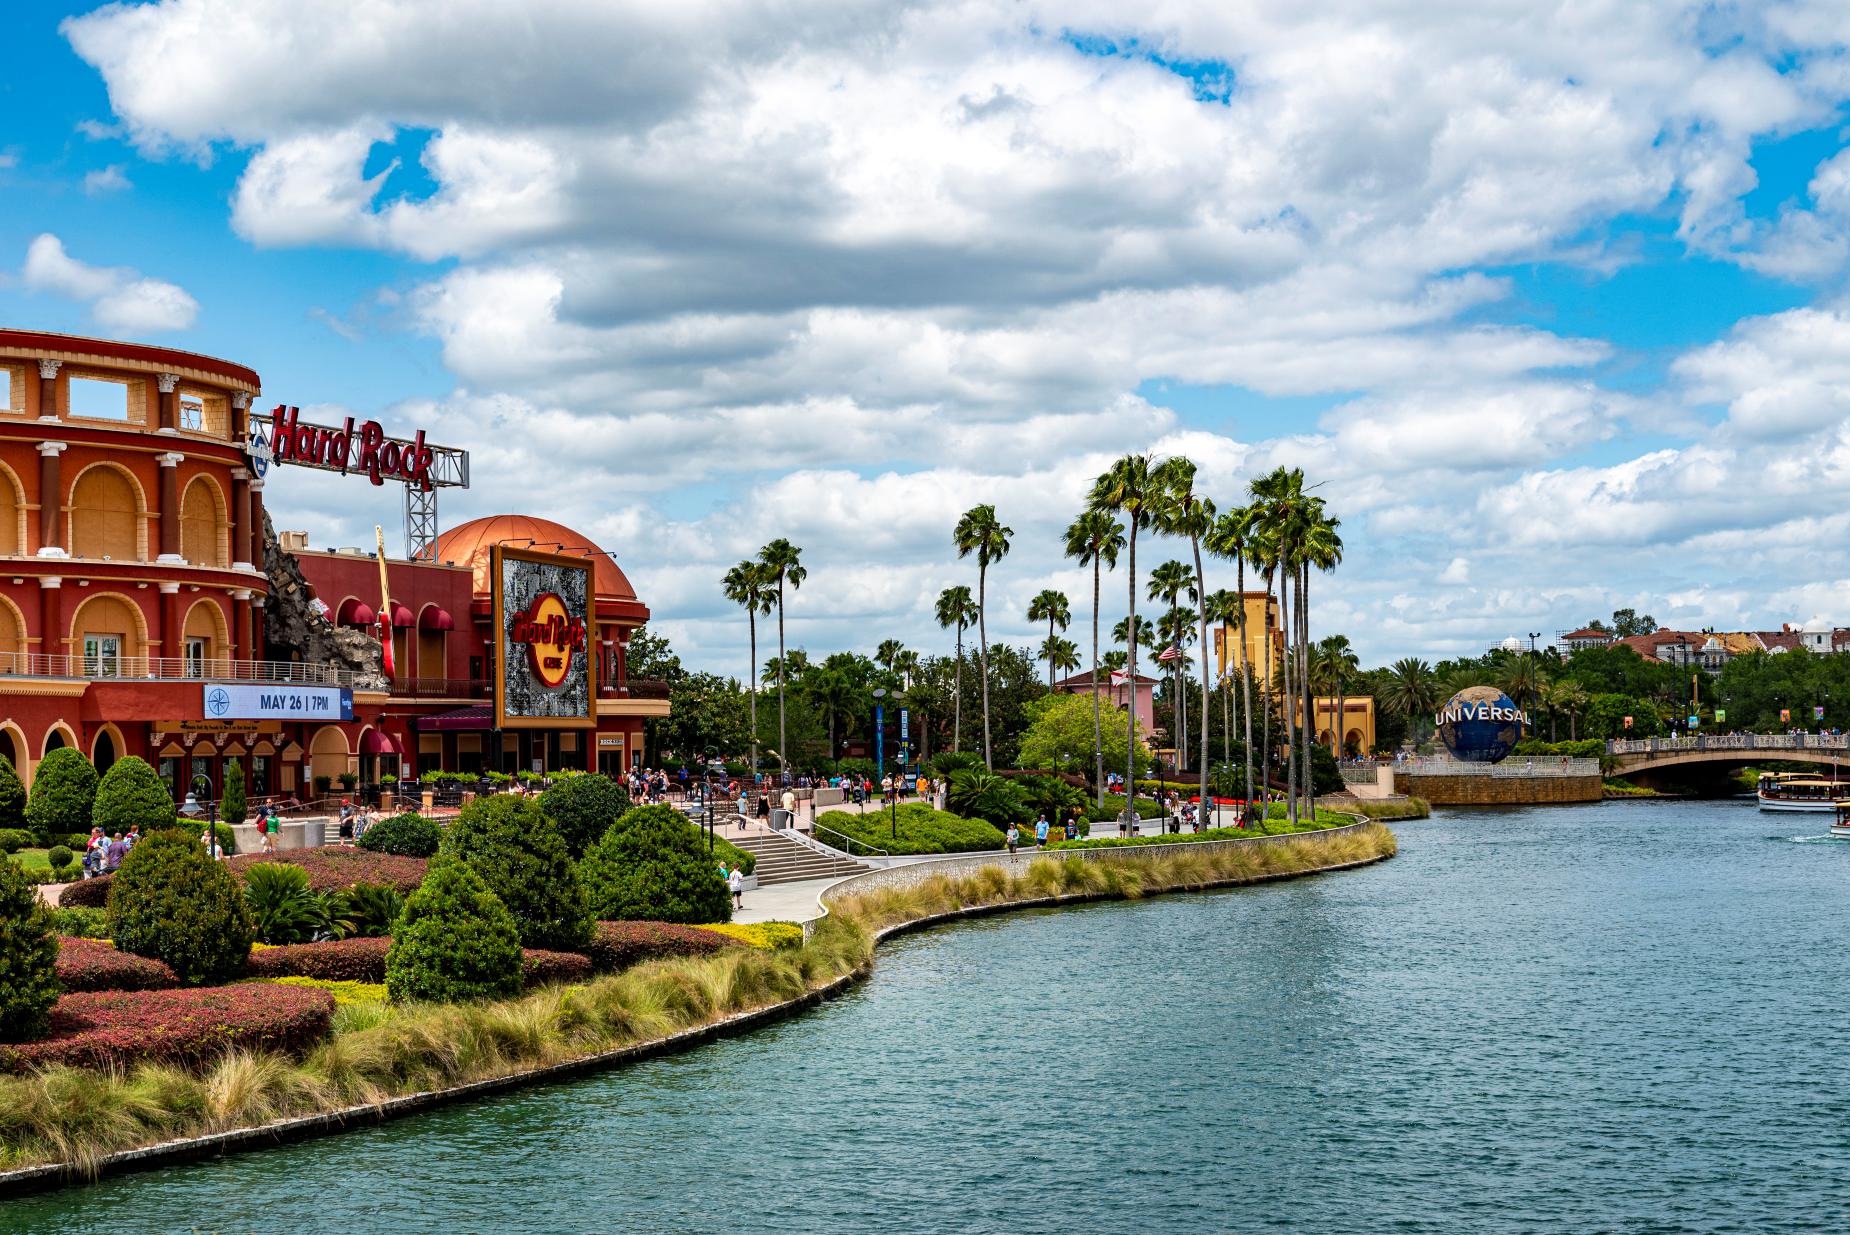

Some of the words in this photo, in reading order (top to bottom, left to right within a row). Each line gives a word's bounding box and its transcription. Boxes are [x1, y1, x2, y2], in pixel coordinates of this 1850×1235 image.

[271, 404, 355, 468] Hard
[358, 420, 434, 492] Rock
[260, 694, 286, 710] MAY
[289, 695, 302, 710] 26
[312, 695, 329, 711] 7PM
[1435, 707, 1531, 725] UNIVERSAL
